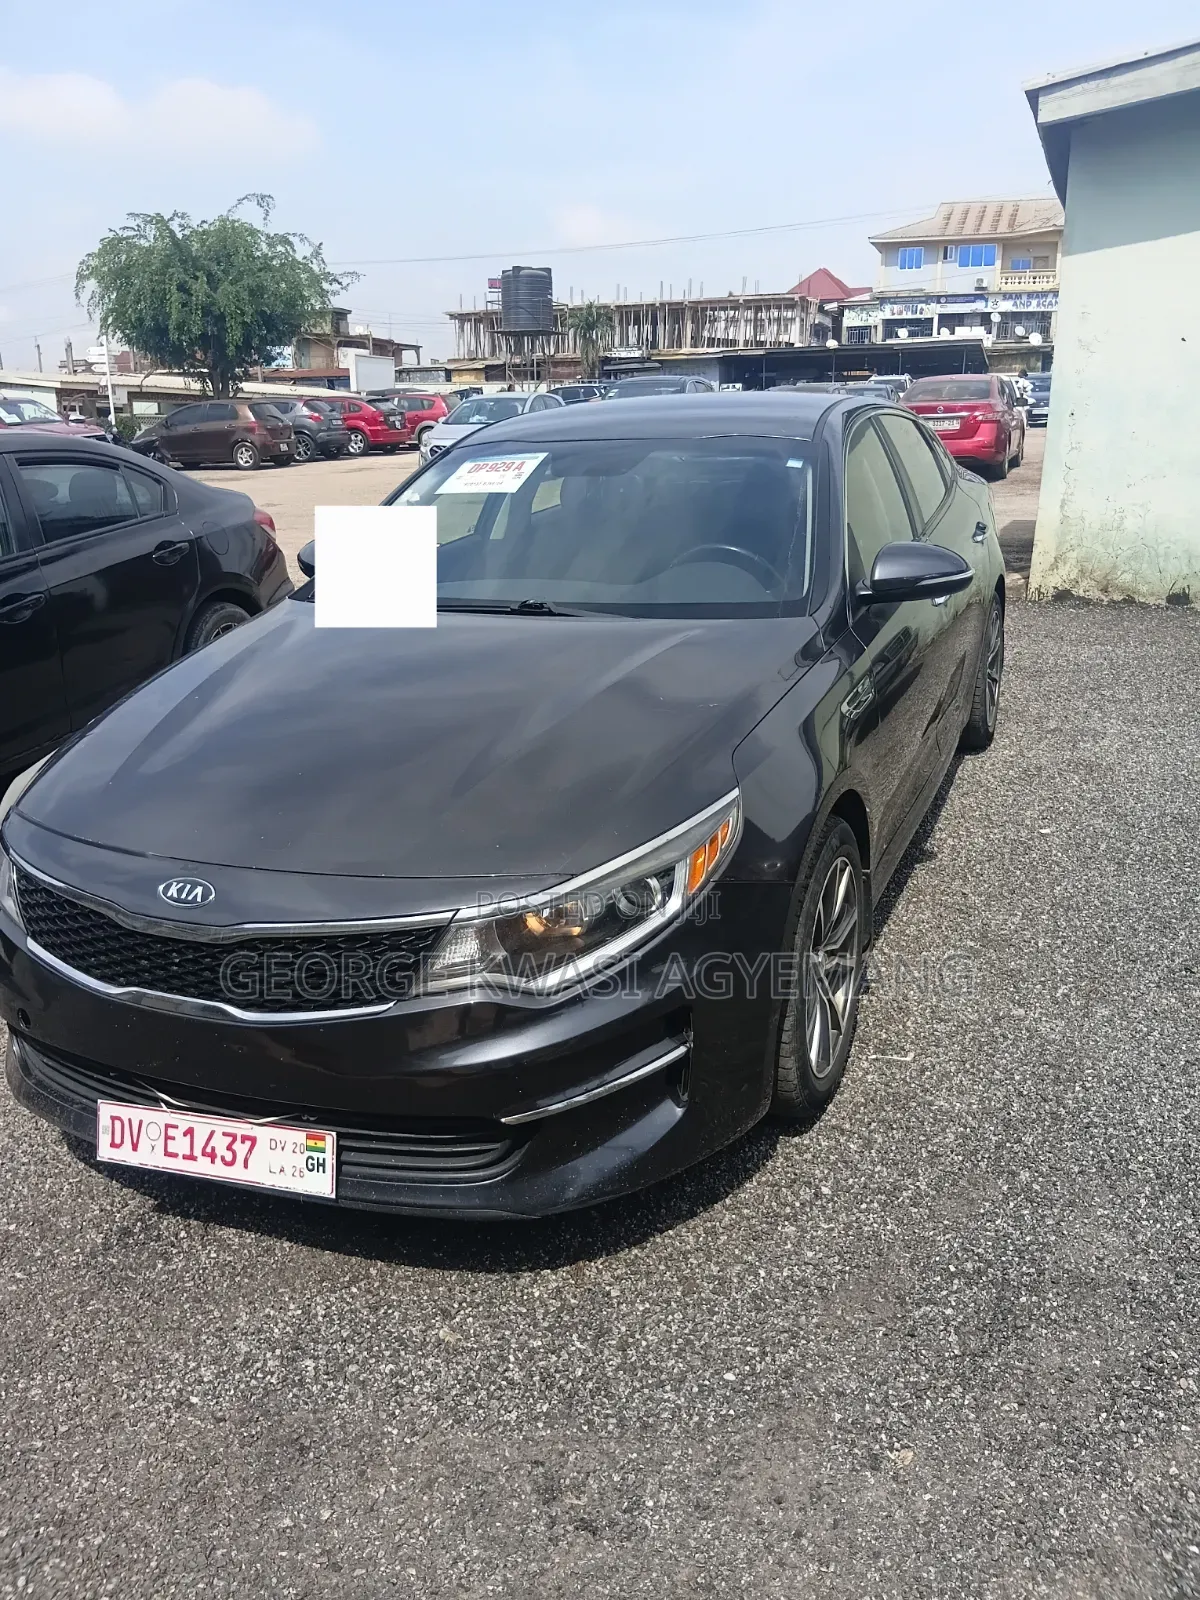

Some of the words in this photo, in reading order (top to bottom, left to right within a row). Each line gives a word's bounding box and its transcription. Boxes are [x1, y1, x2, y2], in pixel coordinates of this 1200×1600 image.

[1002, 293, 1023, 301] SAM
[1012, 300, 1032, 309] AND
[98, 385, 117, 396] OPN
[166, 881, 204, 903] KIA
[109, 1114, 144, 1152] DV
[163, 1123, 258, 1170] E1437
[269, 1138, 287, 1152] DV
[292, 1141, 306, 1155] 20
[305, 1155, 327, 1174] GH
